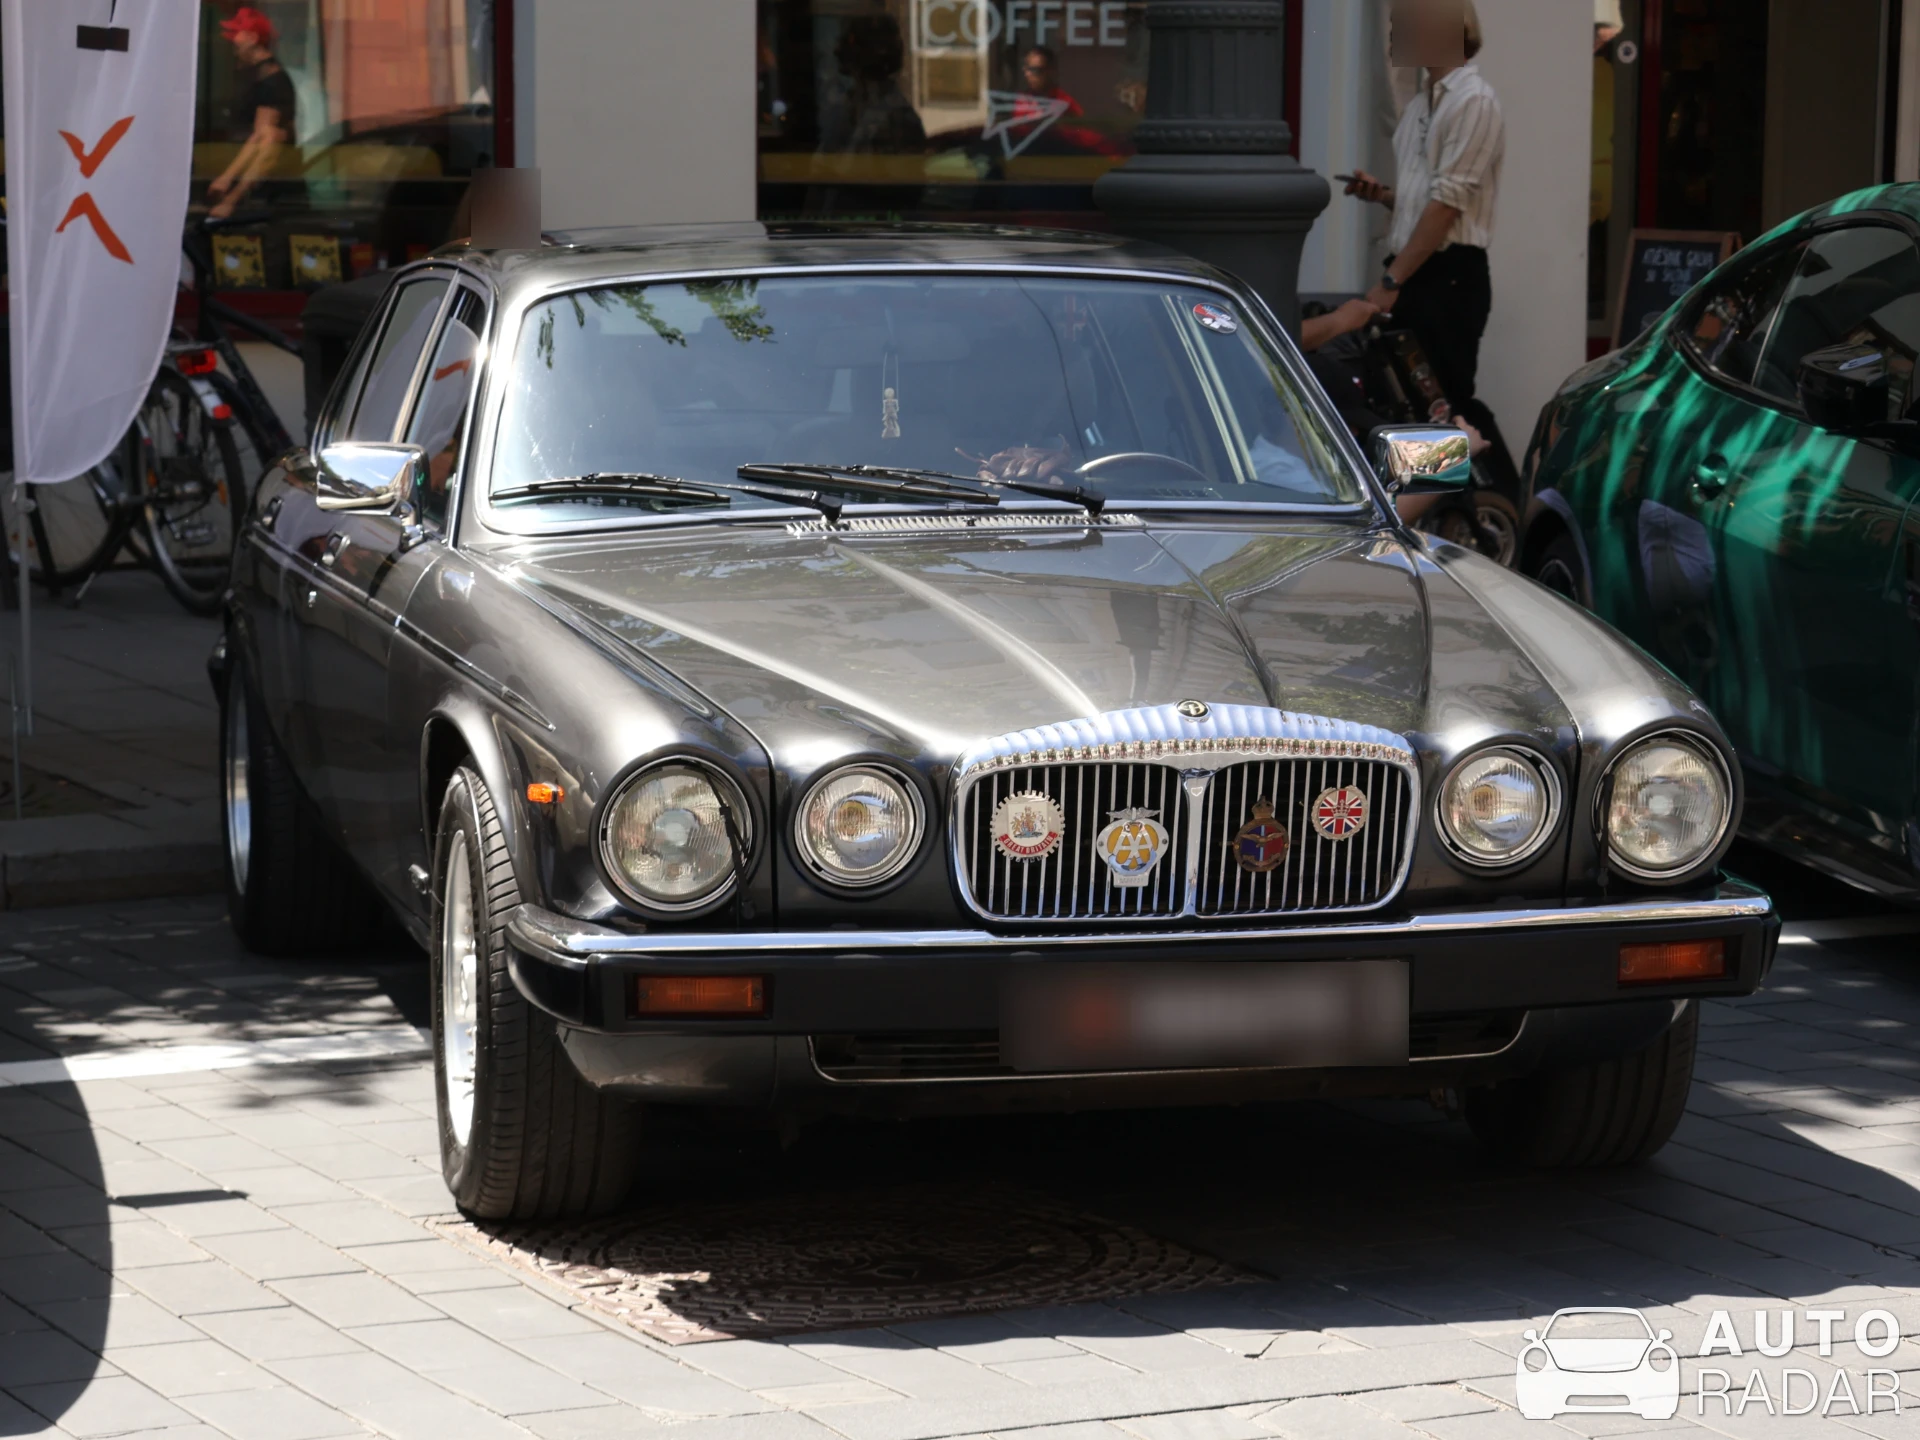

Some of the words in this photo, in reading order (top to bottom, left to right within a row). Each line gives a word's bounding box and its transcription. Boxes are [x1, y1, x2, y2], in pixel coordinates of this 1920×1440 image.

[923, 0, 1127, 46] COFFEE
[1003, 838, 1024, 853] GREAT
[1025, 836, 1053, 854] BRITAIN
[1112, 831, 1154, 864] AA
